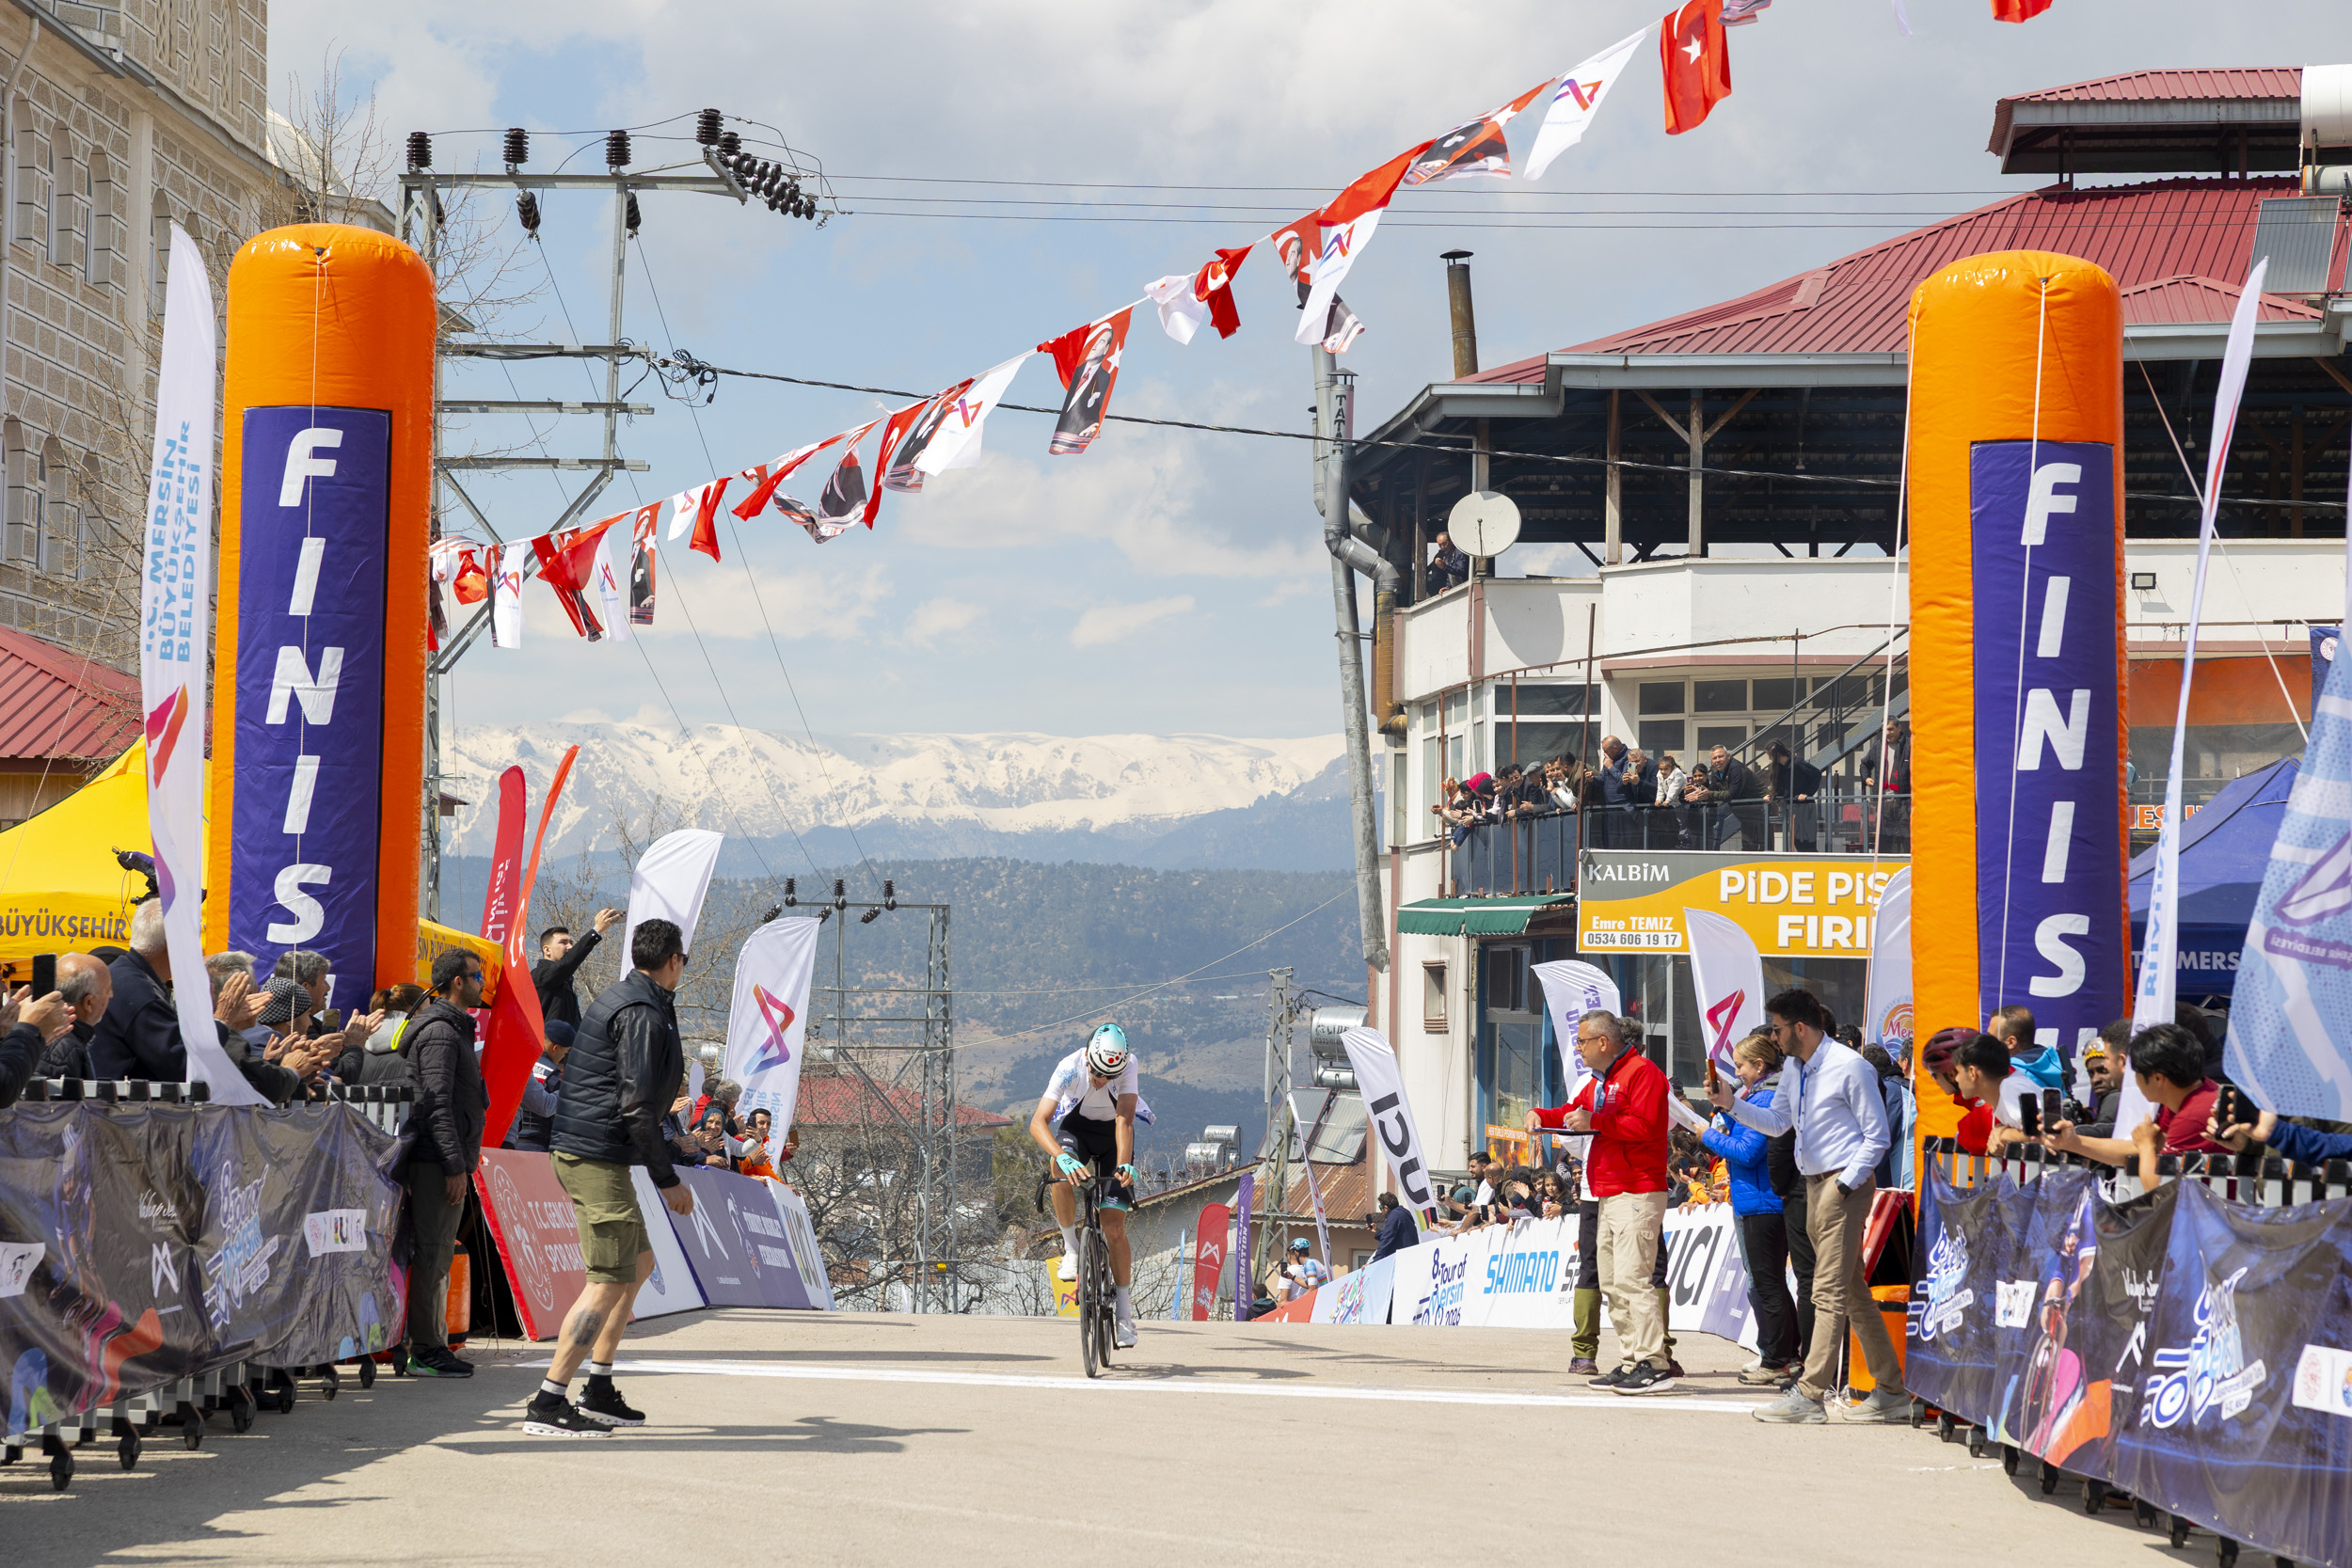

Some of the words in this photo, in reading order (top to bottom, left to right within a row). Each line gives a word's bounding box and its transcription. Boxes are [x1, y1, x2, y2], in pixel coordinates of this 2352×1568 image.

[149, 438, 177, 585] MERSİN
[176, 463, 201, 663] BELEDİYESİ
[1588, 863, 1670, 882] KALBİM
[1720, 869, 1816, 905] PİDE
[1587, 933, 1616, 944] 0534
[1620, 933, 1642, 945] 606
[1646, 934, 1660, 945] 19
[1664, 934, 1677, 945] 17
[1592, 915, 1626, 930] Emre
[1777, 914, 1877, 949] FIRI
[2176, 951, 2240, 971] MERS
[1882, 1020, 1914, 1038] Mer
[545, 1243, 570, 1273] SPOR
[1239, 1226, 1248, 1309] FEDERATION
[1440, 1262, 1457, 1286] Tour
[1457, 1253, 1468, 1279] of
[1484, 1250, 1559, 1294] SHIMANO
[1429, 1281, 1464, 1316] Mersin
